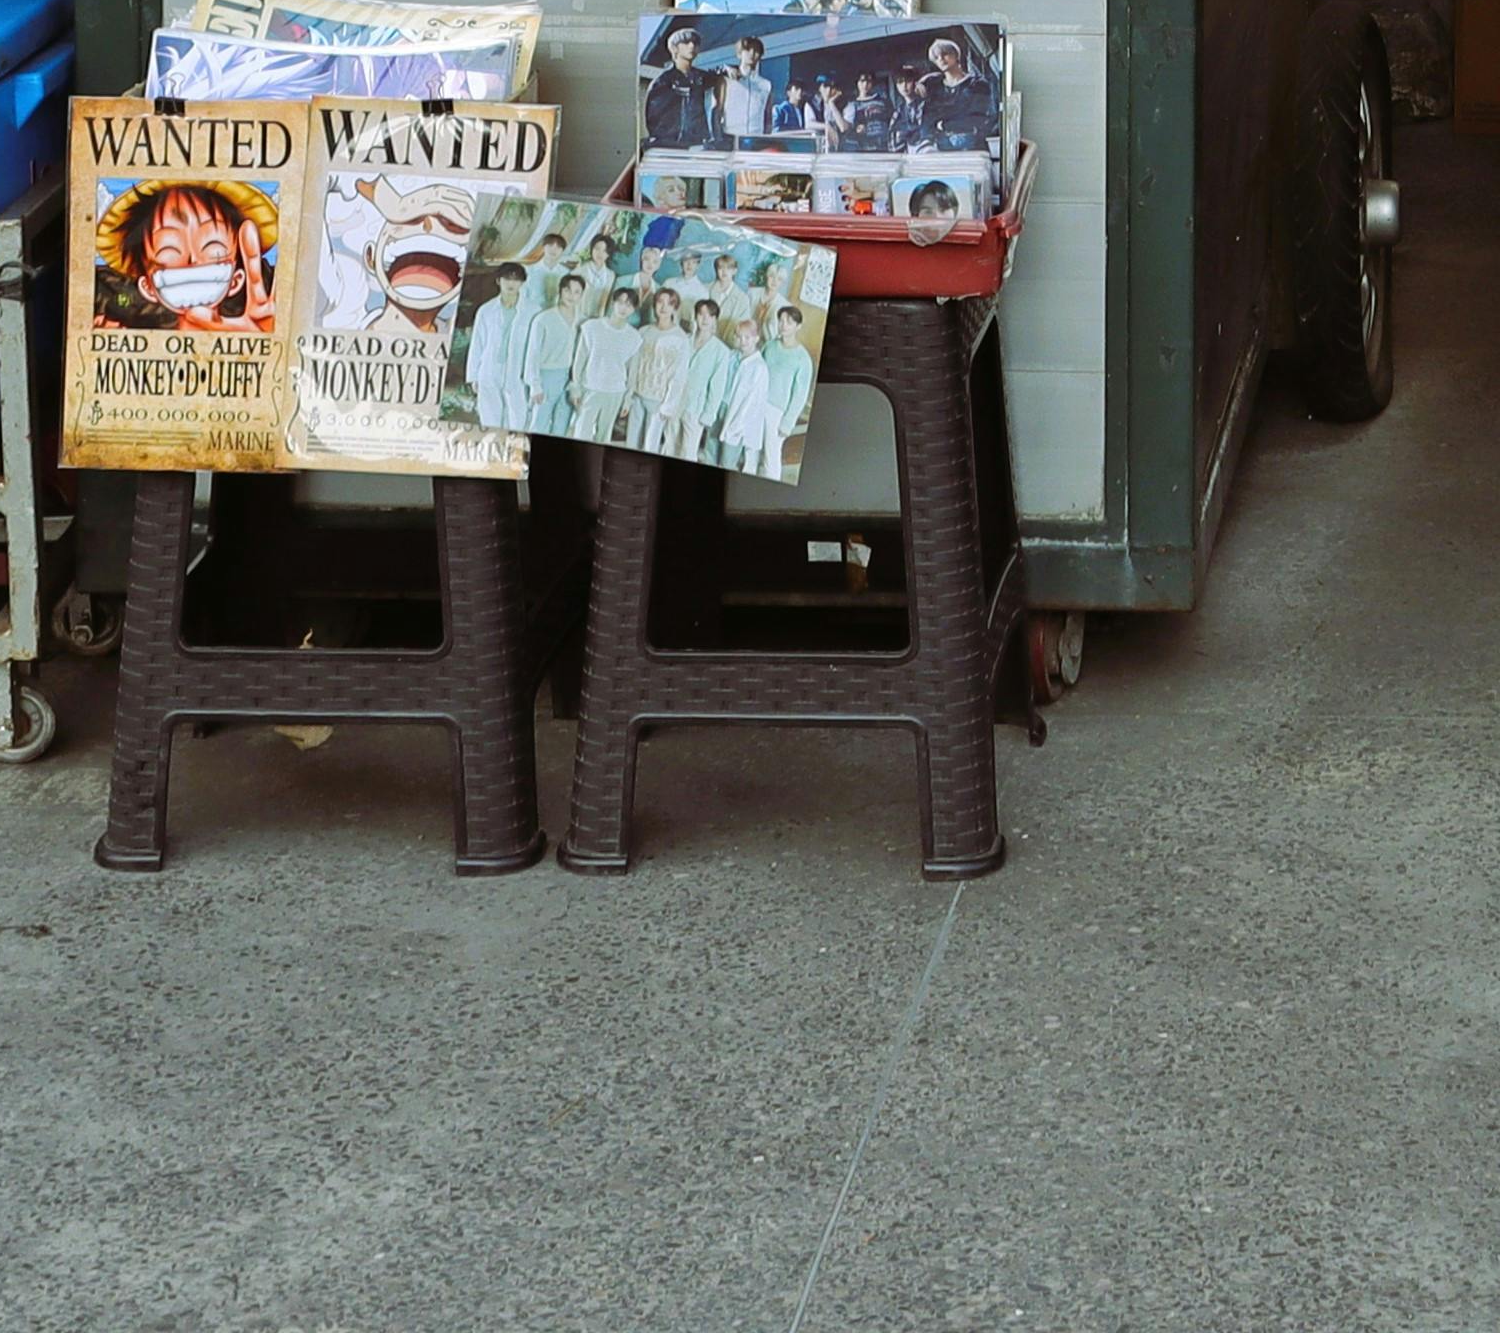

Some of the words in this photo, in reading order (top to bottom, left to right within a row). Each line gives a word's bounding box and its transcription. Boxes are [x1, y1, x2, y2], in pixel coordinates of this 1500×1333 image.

[84, 116, 292, 168] WANTED
[320, 108, 548, 173] WANTED
[91, 336, 148, 354] DEAD
[166, 337, 195, 354] OR
[212, 337, 271, 357] ALIVE
[207, 430, 275, 452] MARINE
